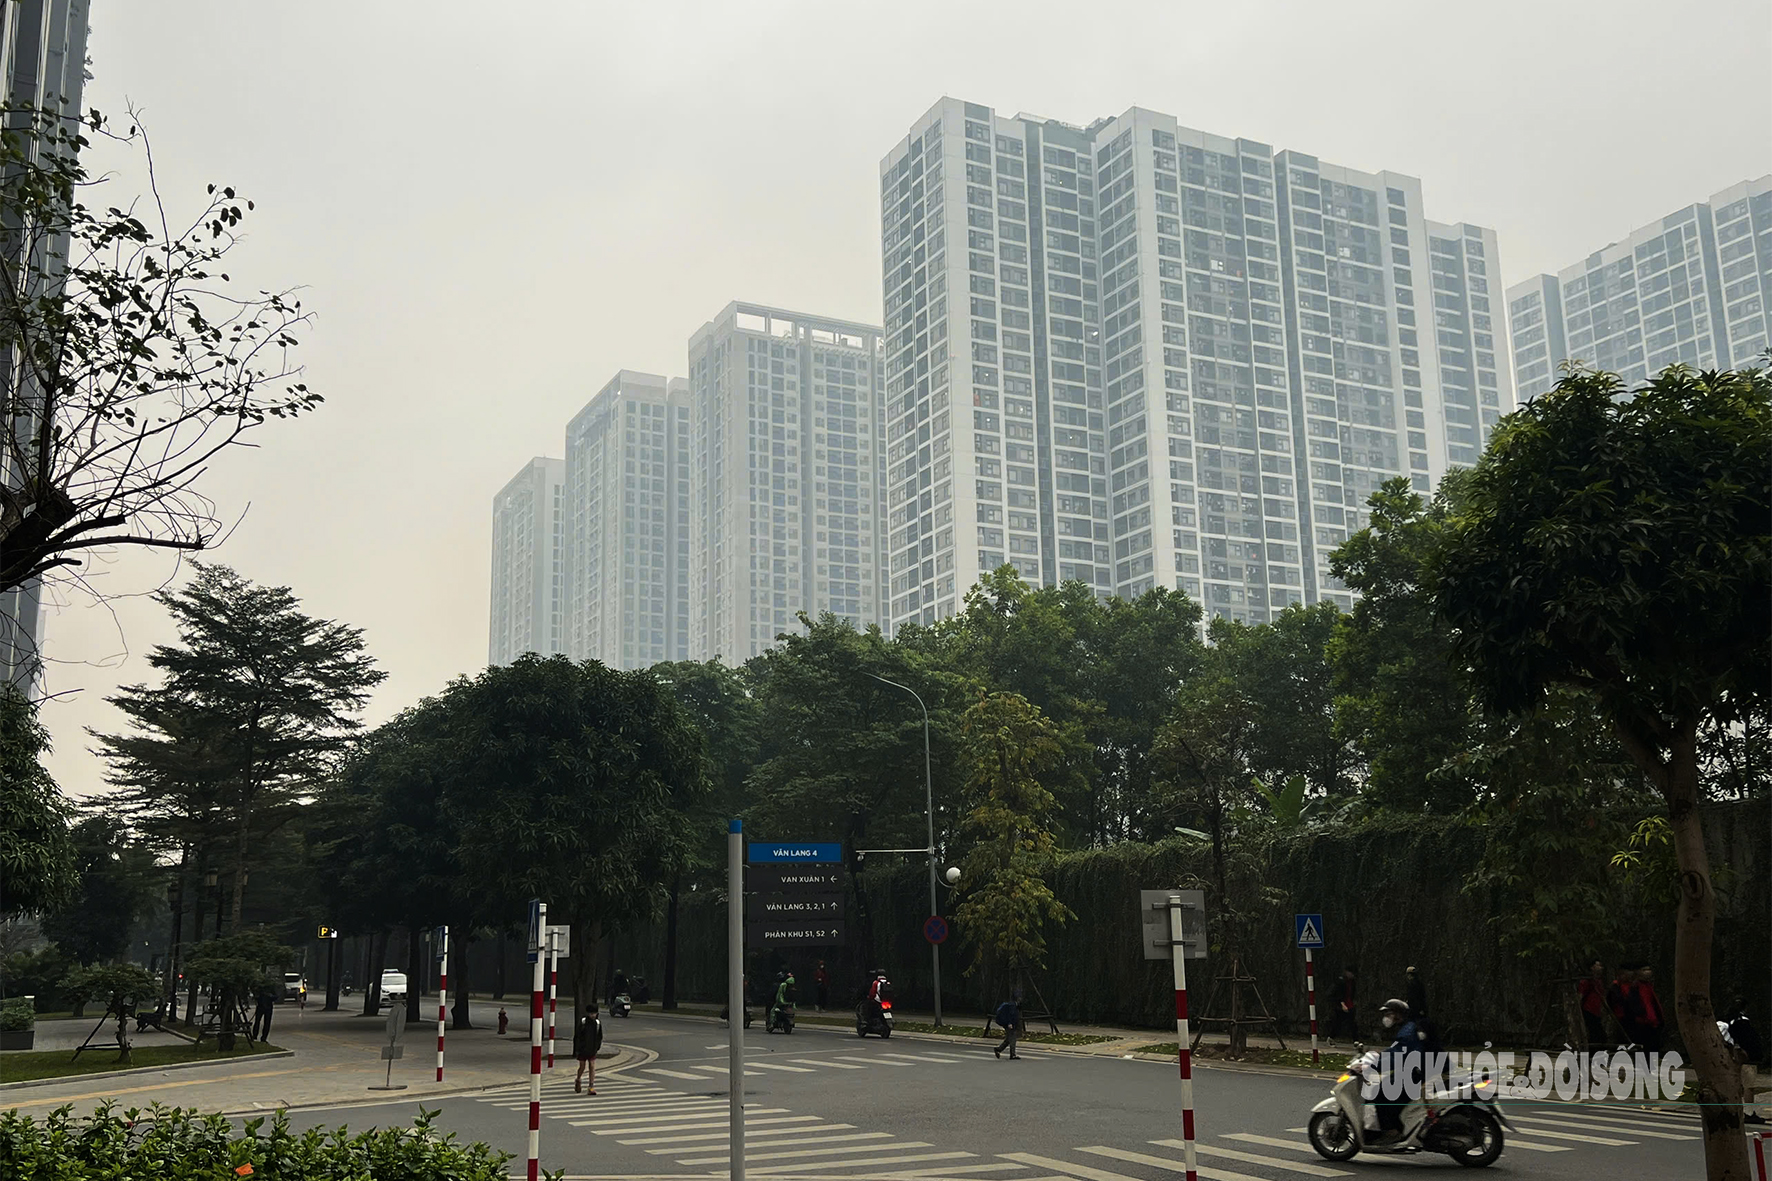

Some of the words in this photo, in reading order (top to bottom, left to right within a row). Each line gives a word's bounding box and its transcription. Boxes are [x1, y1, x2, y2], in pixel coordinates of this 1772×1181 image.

[783, 903, 804, 911] LANG
[806, 903, 813, 911] 3,
[814, 903, 821, 911] 2,
[321, 927, 329, 936] P
